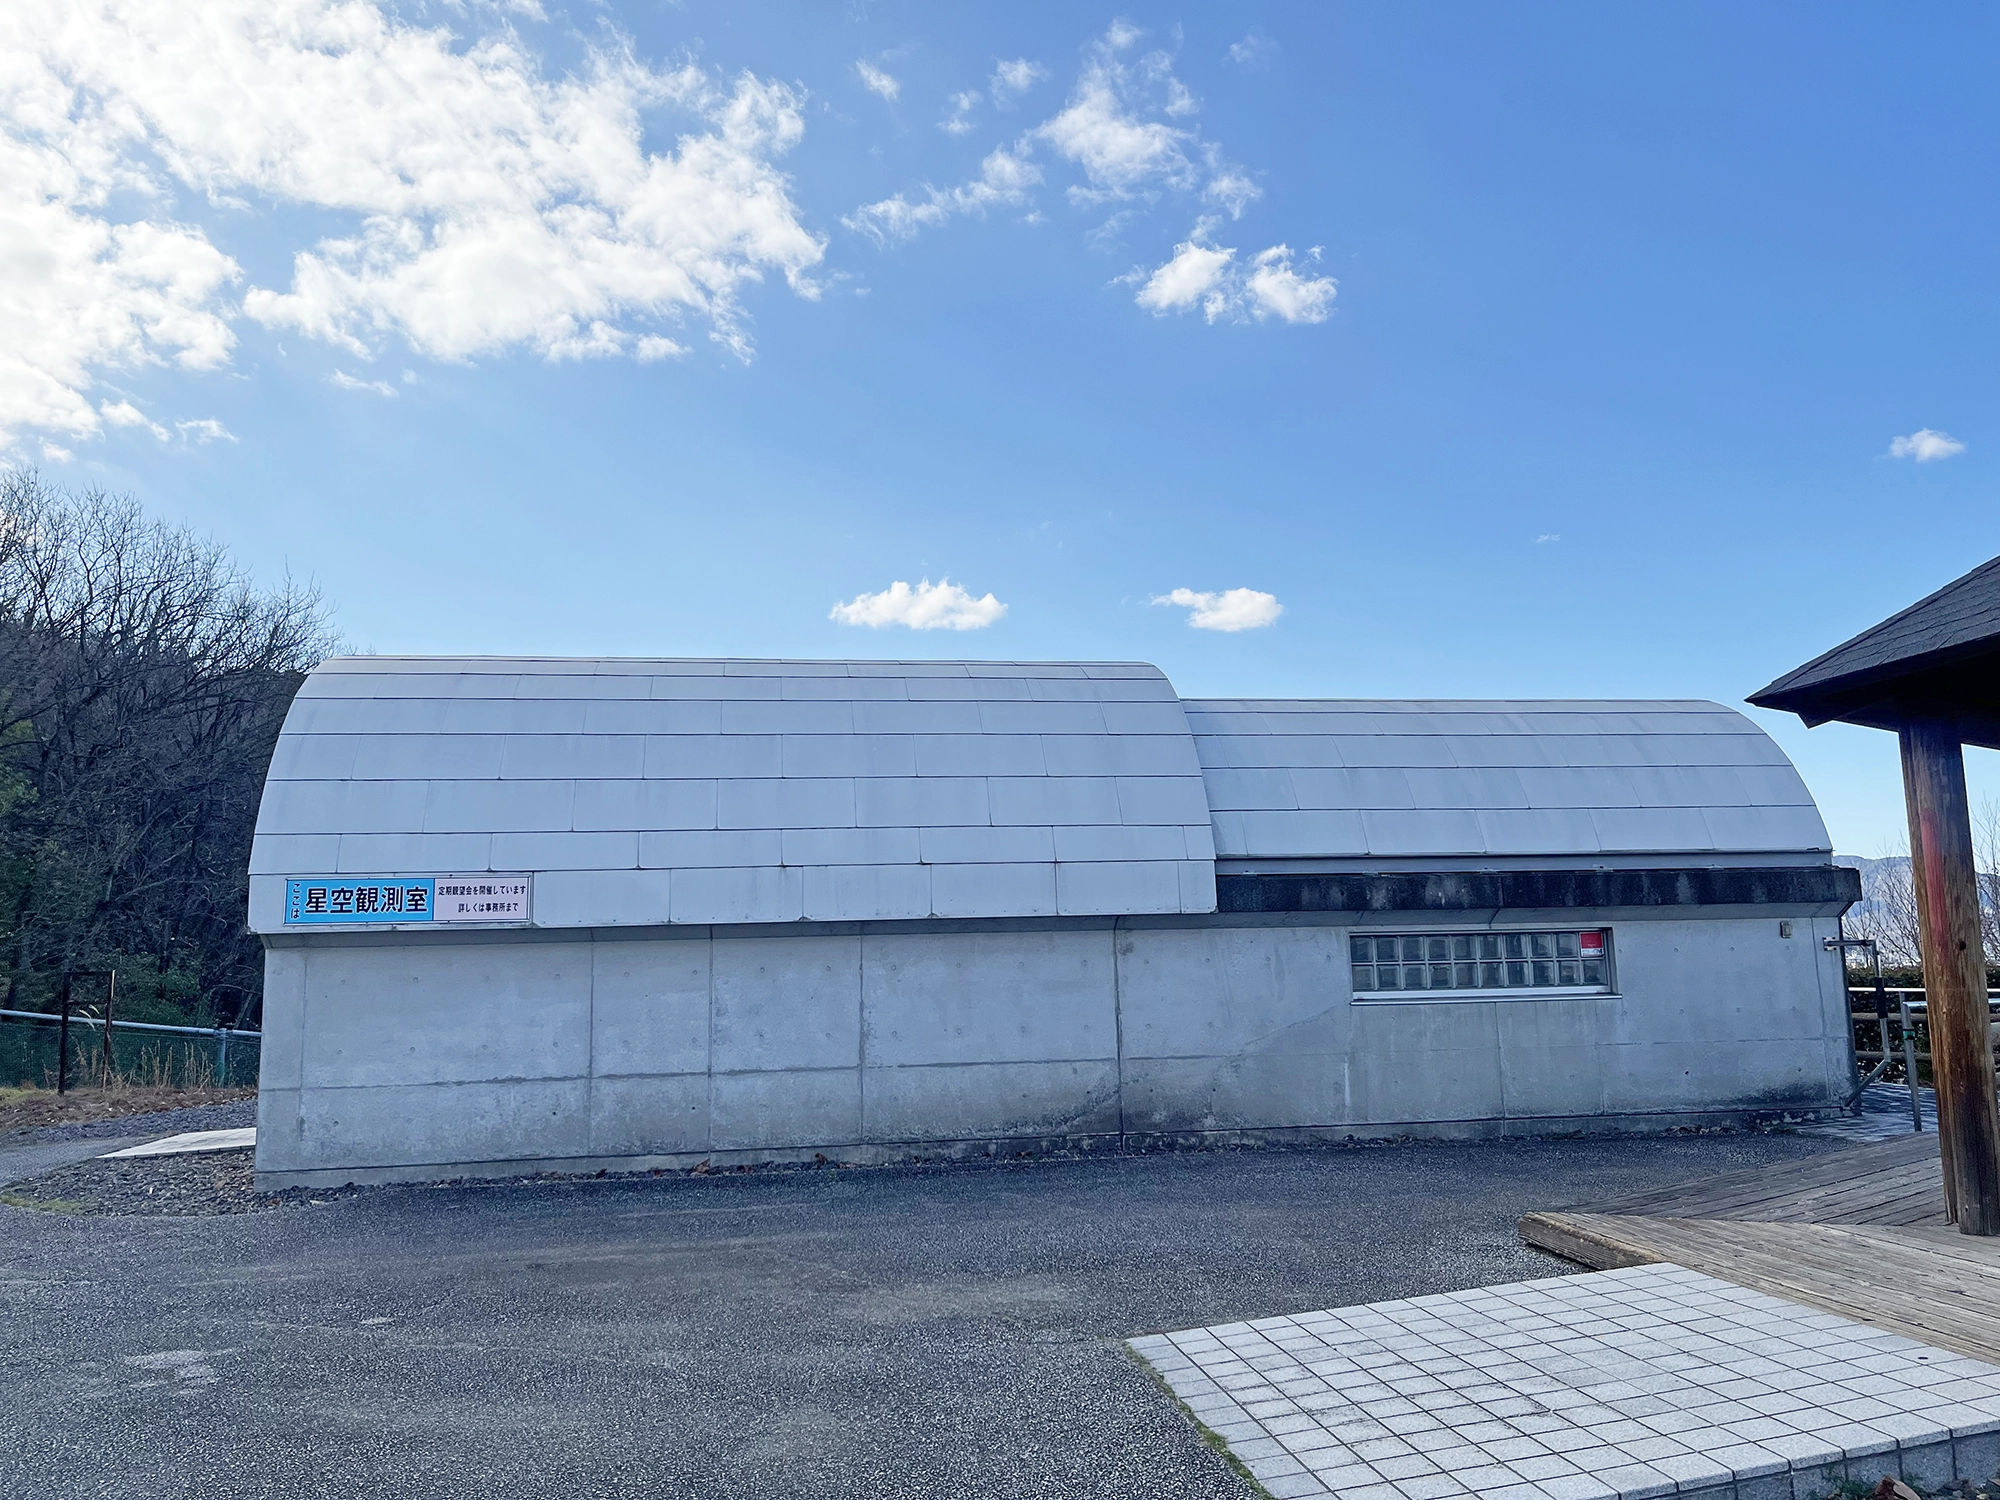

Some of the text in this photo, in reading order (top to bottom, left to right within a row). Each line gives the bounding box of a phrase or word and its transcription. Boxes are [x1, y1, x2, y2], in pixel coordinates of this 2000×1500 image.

[304, 886, 428, 914] 星空観測室
[437, 885, 526, 896] 定期観望会を開催しています
[290, 883, 301, 919] ここは
[457, 902, 519, 913] 詳しくは事務所まで
